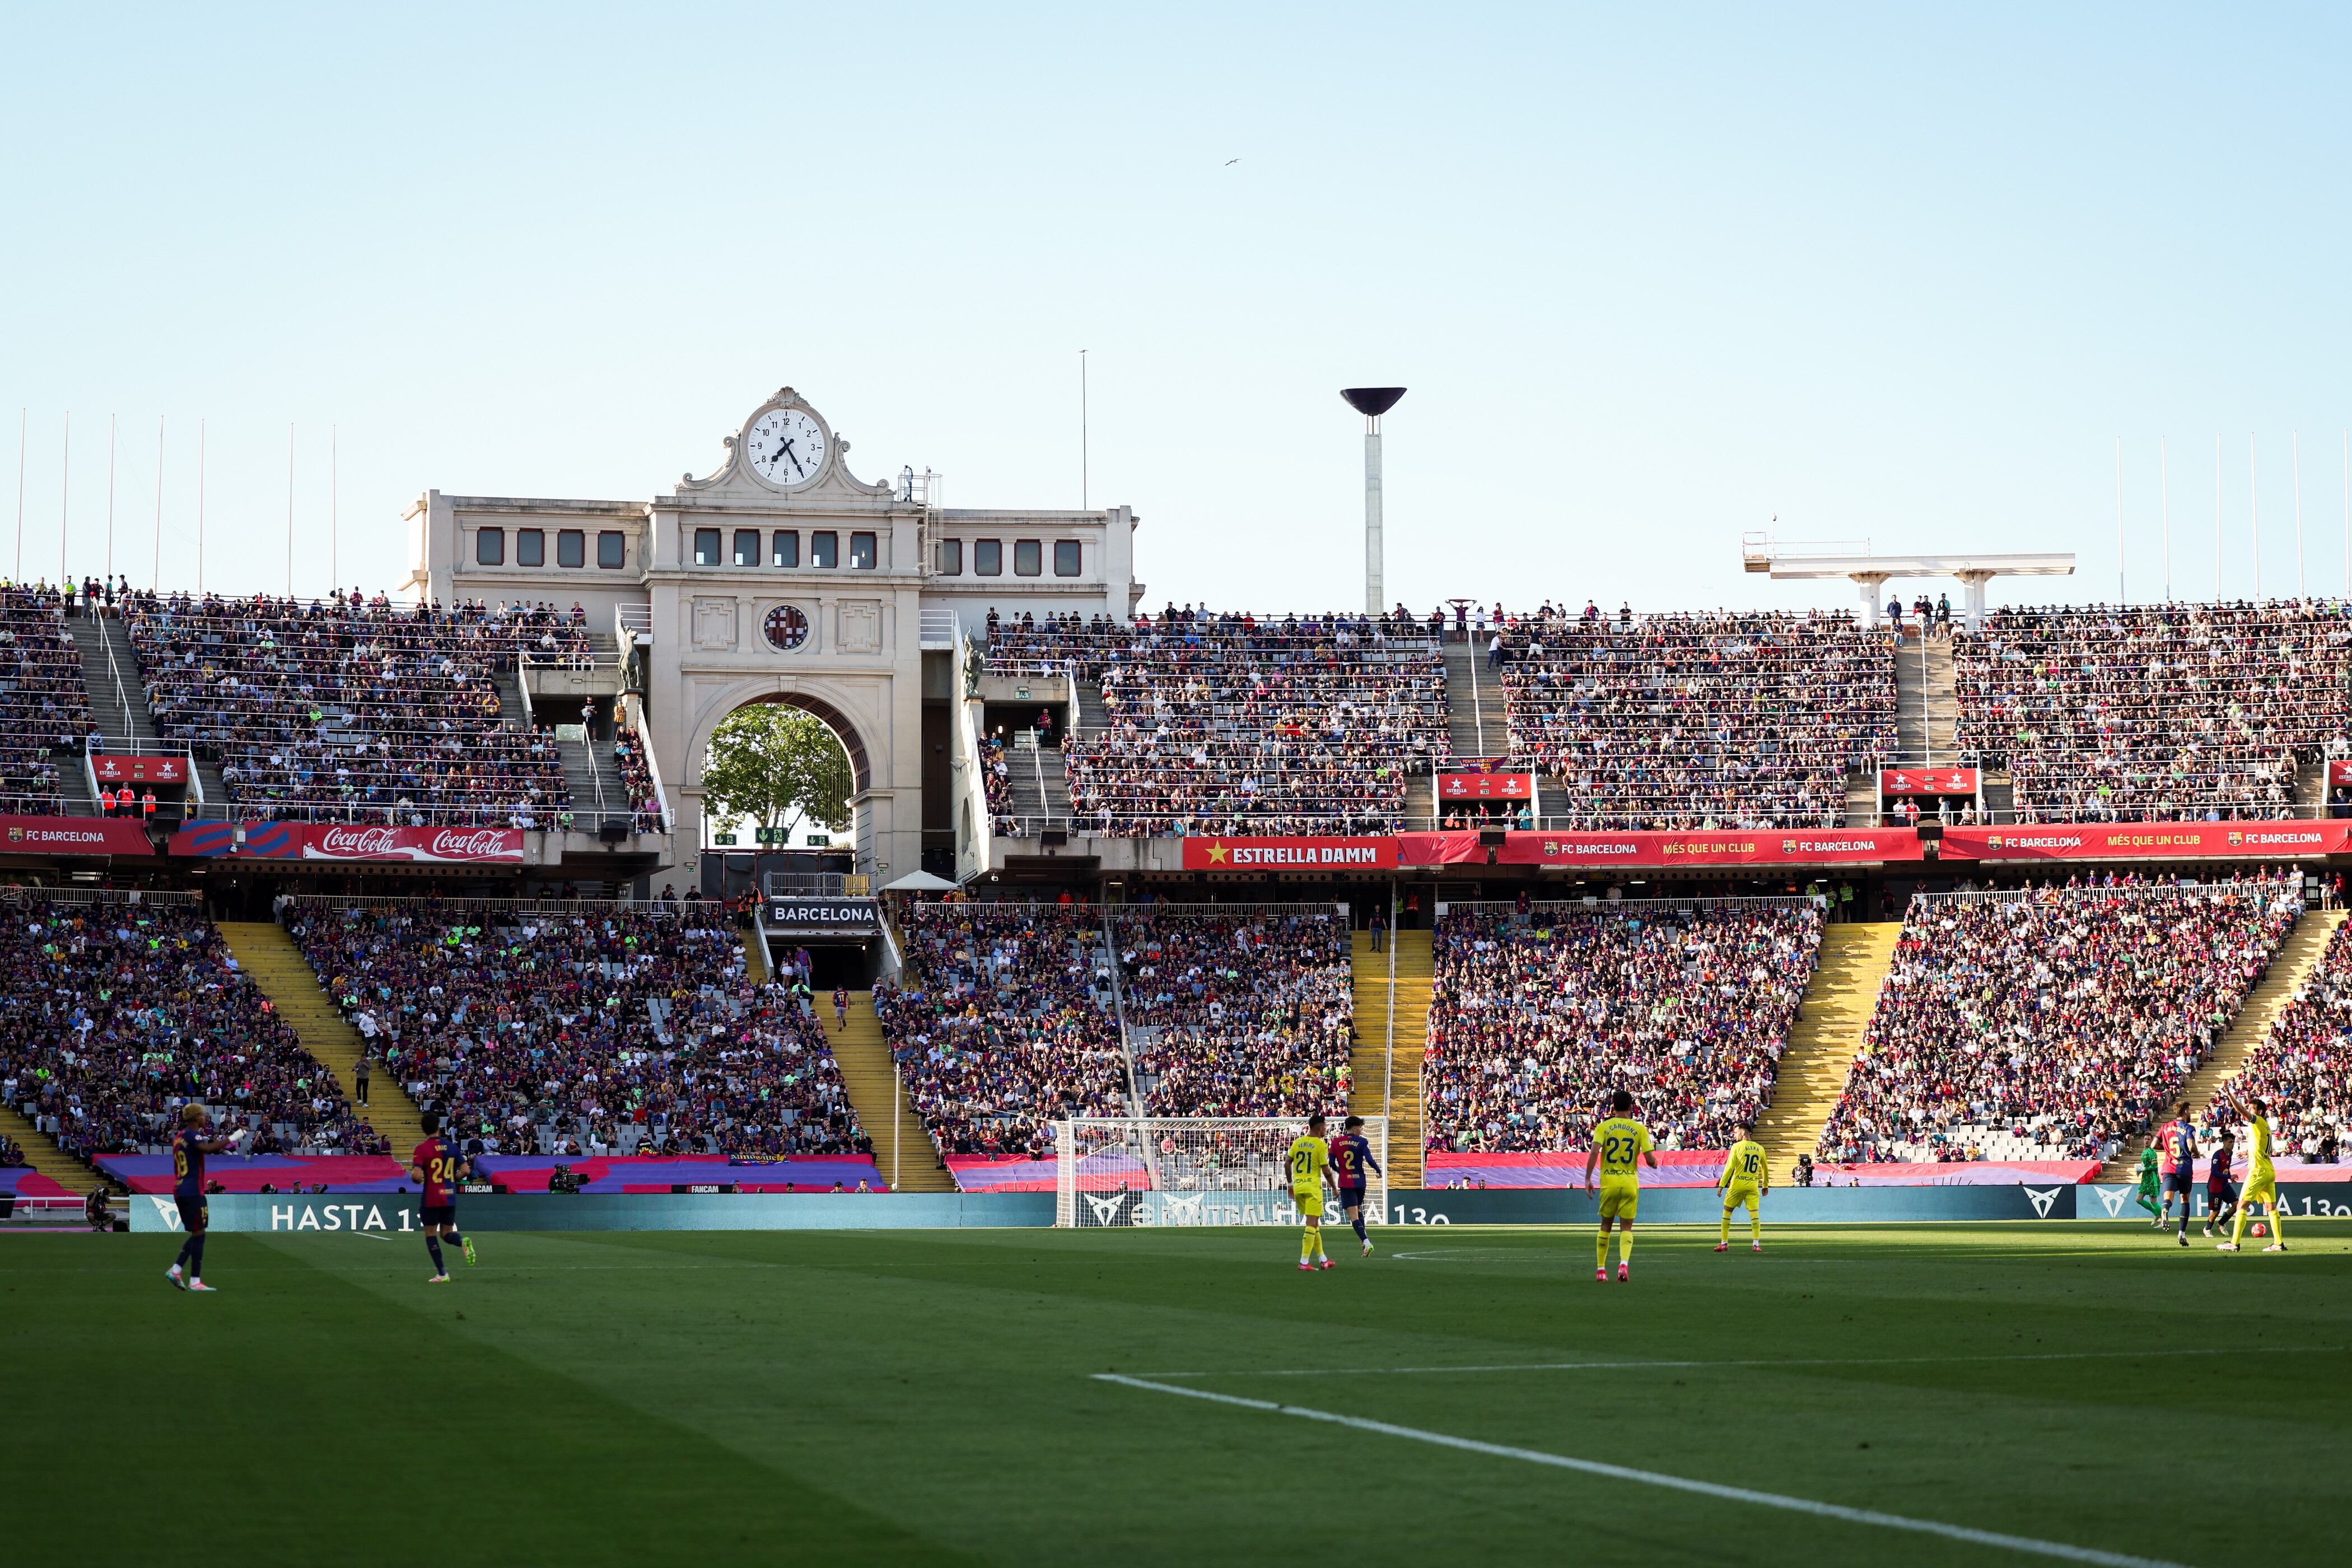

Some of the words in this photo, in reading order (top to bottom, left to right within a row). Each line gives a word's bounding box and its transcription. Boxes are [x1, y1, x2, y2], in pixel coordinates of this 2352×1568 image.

[26, 830, 39, 841] FC
[41, 830, 105, 843] BARCELONA
[323, 827, 398, 852] Coca-Cola
[432, 829, 508, 855] Coca-Cola
[2005, 838, 2018, 848] FC
[2020, 837, 2082, 847] BARCELONA
[2107, 834, 2130, 846] MÉS
[2132, 836, 2154, 847] QUE
[2156, 835, 2171, 845] UN
[2173, 835, 2201, 845] CLUB
[2246, 834, 2258, 844] FC
[2260, 833, 2322, 843] BARCELONA
[1561, 844, 1574, 854] FC
[1576, 844, 1637, 854] BARCELONA
[1663, 842, 1685, 855] MÉS
[1687, 843, 1709, 855] QUE
[1711, 843, 1726, 853] UN
[1728, 843, 1755, 853] CLUB
[1800, 842, 1813, 852] FC
[1814, 841, 1875, 851] BARCELONA
[1233, 847, 1317, 864] ESTRELLA
[1321, 847, 1376, 863] DAMM
[775, 907, 875, 921] BARCELONA
[1606, 1137, 1635, 1165] 23
[2169, 1136, 2181, 1158] 5
[1296, 1151, 1312, 1174] 21
[1343, 1150, 1355, 1170] 2
[1744, 1154, 1759, 1174] 16
[431, 1157, 455, 1183] 24
[460, 1185, 493, 1193] #FANCAM
[272, 1205, 386, 1230] HASTA
